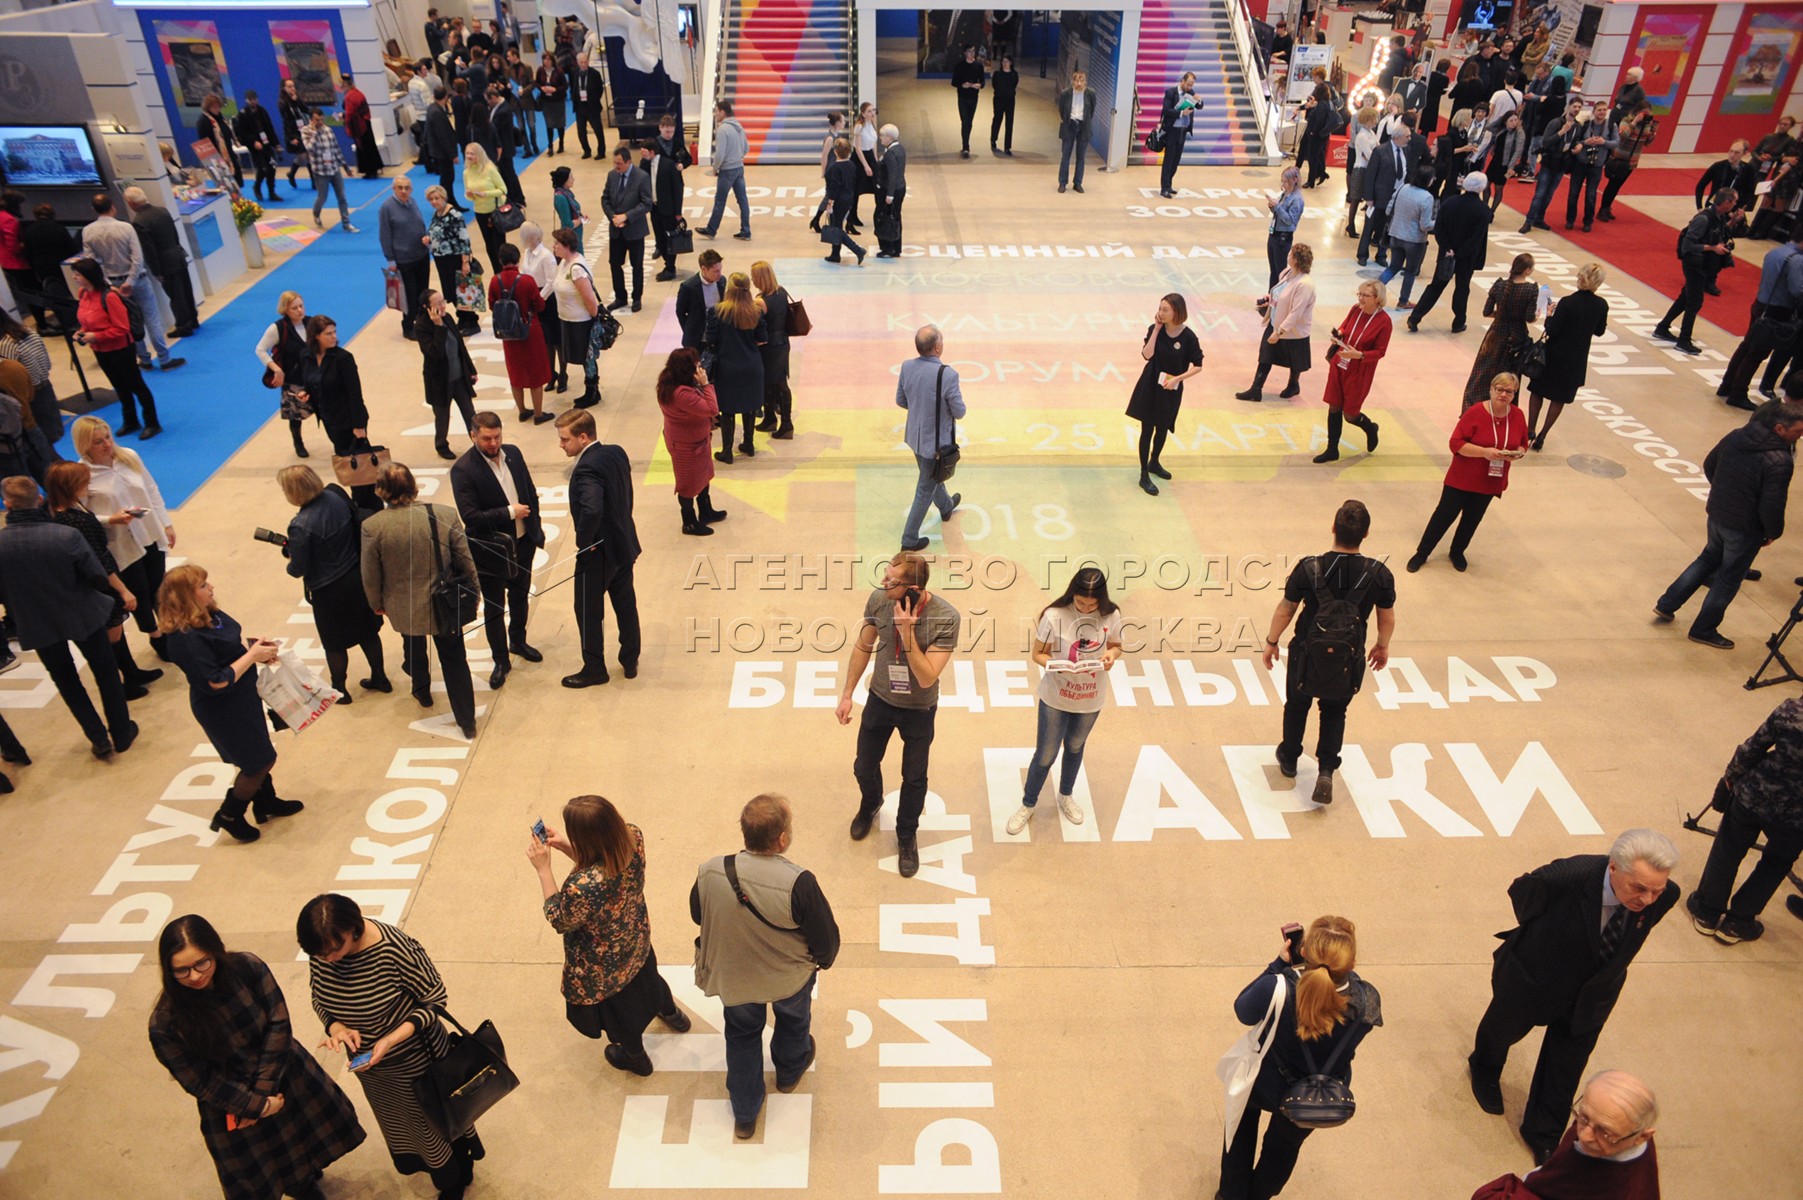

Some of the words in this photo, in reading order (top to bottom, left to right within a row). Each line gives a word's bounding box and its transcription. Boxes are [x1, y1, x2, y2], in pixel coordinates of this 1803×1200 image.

[1151, 246, 1246, 260] ДАР
[885, 268, 1262, 287] МОСКОВСКИЙ
[886, 311, 1240, 333] КУЛЬТУРНЙ
[889, 360, 1127, 384] ОРУМ
[1028, 423, 1105, 450] 25
[916, 503, 1077, 542] 2018
[1066, 682, 1097, 691] КУЛЬТУРА
[1373, 656, 1558, 709] ДАР
[982, 742, 1603, 843] ПАРКИ
